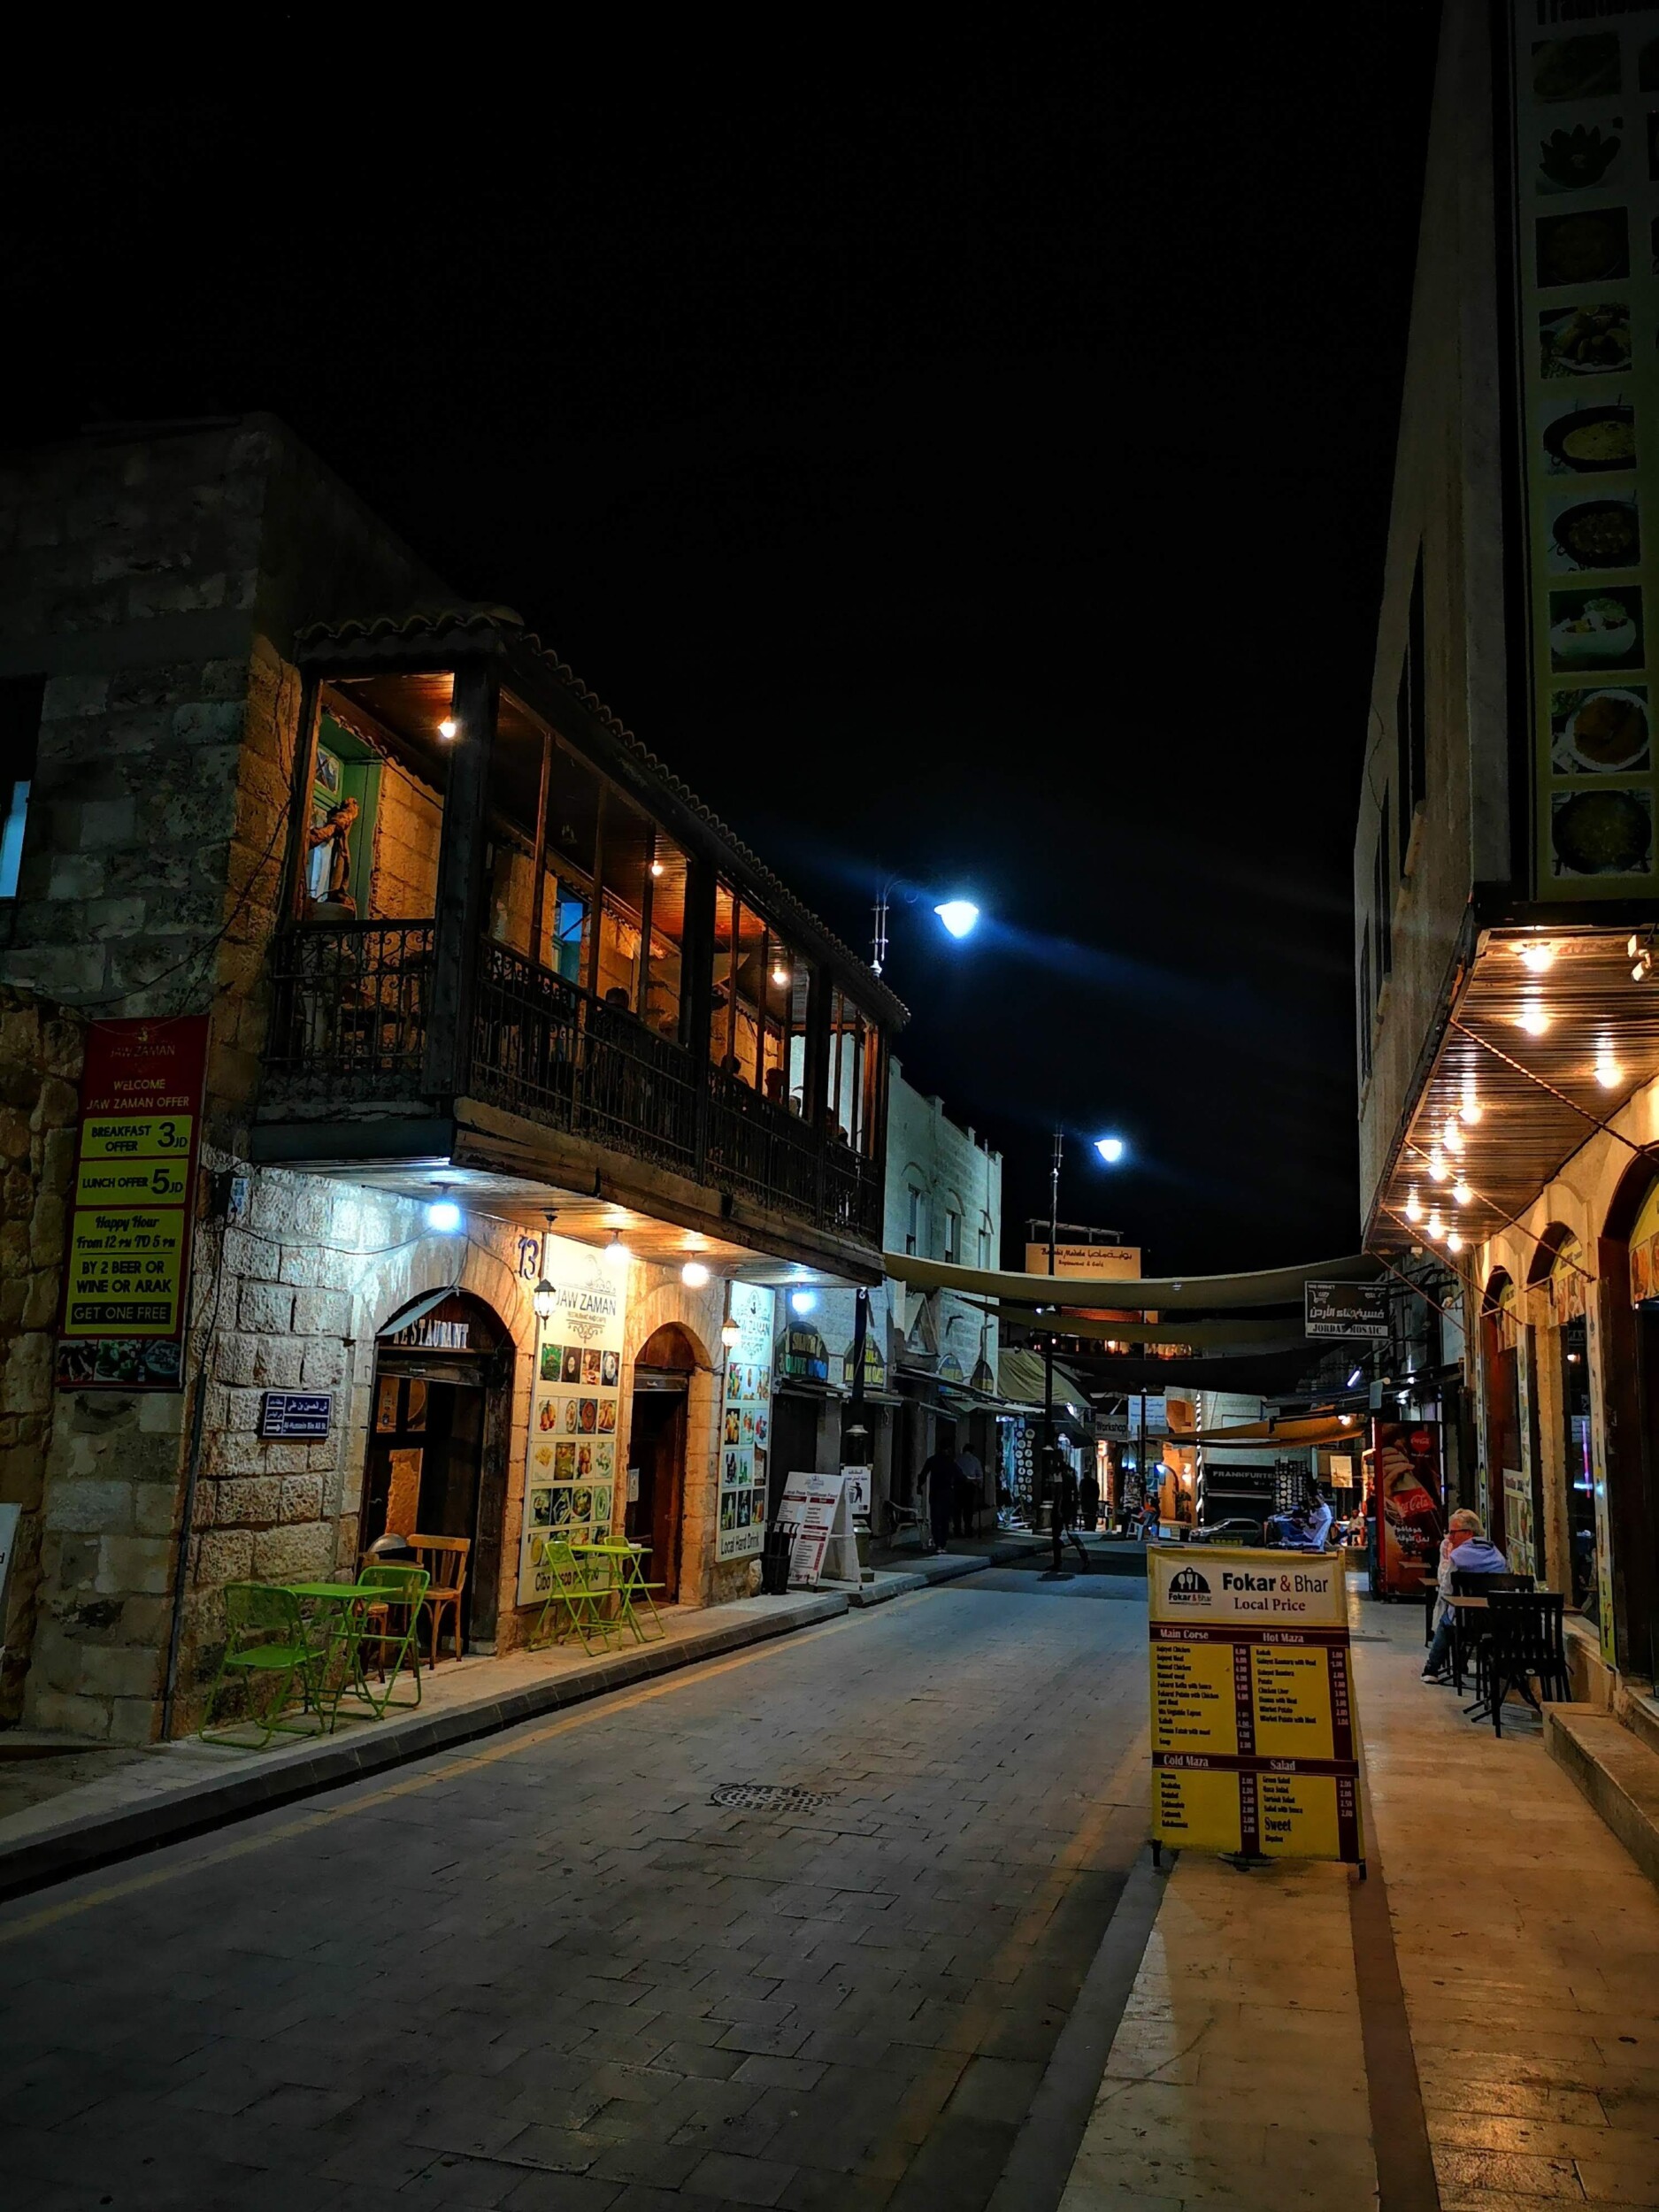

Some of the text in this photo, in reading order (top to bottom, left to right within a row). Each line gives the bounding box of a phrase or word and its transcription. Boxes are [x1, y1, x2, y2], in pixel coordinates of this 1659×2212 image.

[134, 1045, 175, 1057] ZAMAN
[113, 1079, 165, 1091] WELCOME
[86, 1096, 188, 1110] JAW ZAMAN OFFER
[91, 1125, 151, 1138] BREAKFAST
[105, 1141, 138, 1152] OFFER
[82, 1178, 115, 1188] LUNCH
[118, 1176, 149, 1187] OFFER
[96, 1215, 159, 1232] Happy Hour
[77, 1236, 103, 1248] From
[104, 1235, 116, 1248] 12
[134, 1235, 150, 1248] TO
[152, 1234, 161, 1248] 5
[518, 1234, 539, 1280] 13
[81, 1260, 164, 1274] BY 2 BEER OR
[77, 1279, 172, 1293] WINE OR ARAK
[556, 1288, 617, 1316] JAW ZAMAN
[73, 1306, 167, 1320] GET ONE FREE
[1097, 1423, 1126, 1434] Workshop
[1222, 1572, 1328, 1593] Fokar & Bhar
[1168, 1593, 1191, 1601] Fokar
[1234, 1597, 1306, 1610] Local Price
[1160, 1628, 1209, 1640] Main Corse
[1263, 1632, 1304, 1643] Hot Maza
[1164, 1755, 1209, 1767] Cold Maza
[1270, 1760, 1295, 1770] Salad
[1264, 1816, 1291, 1832] Sweet
